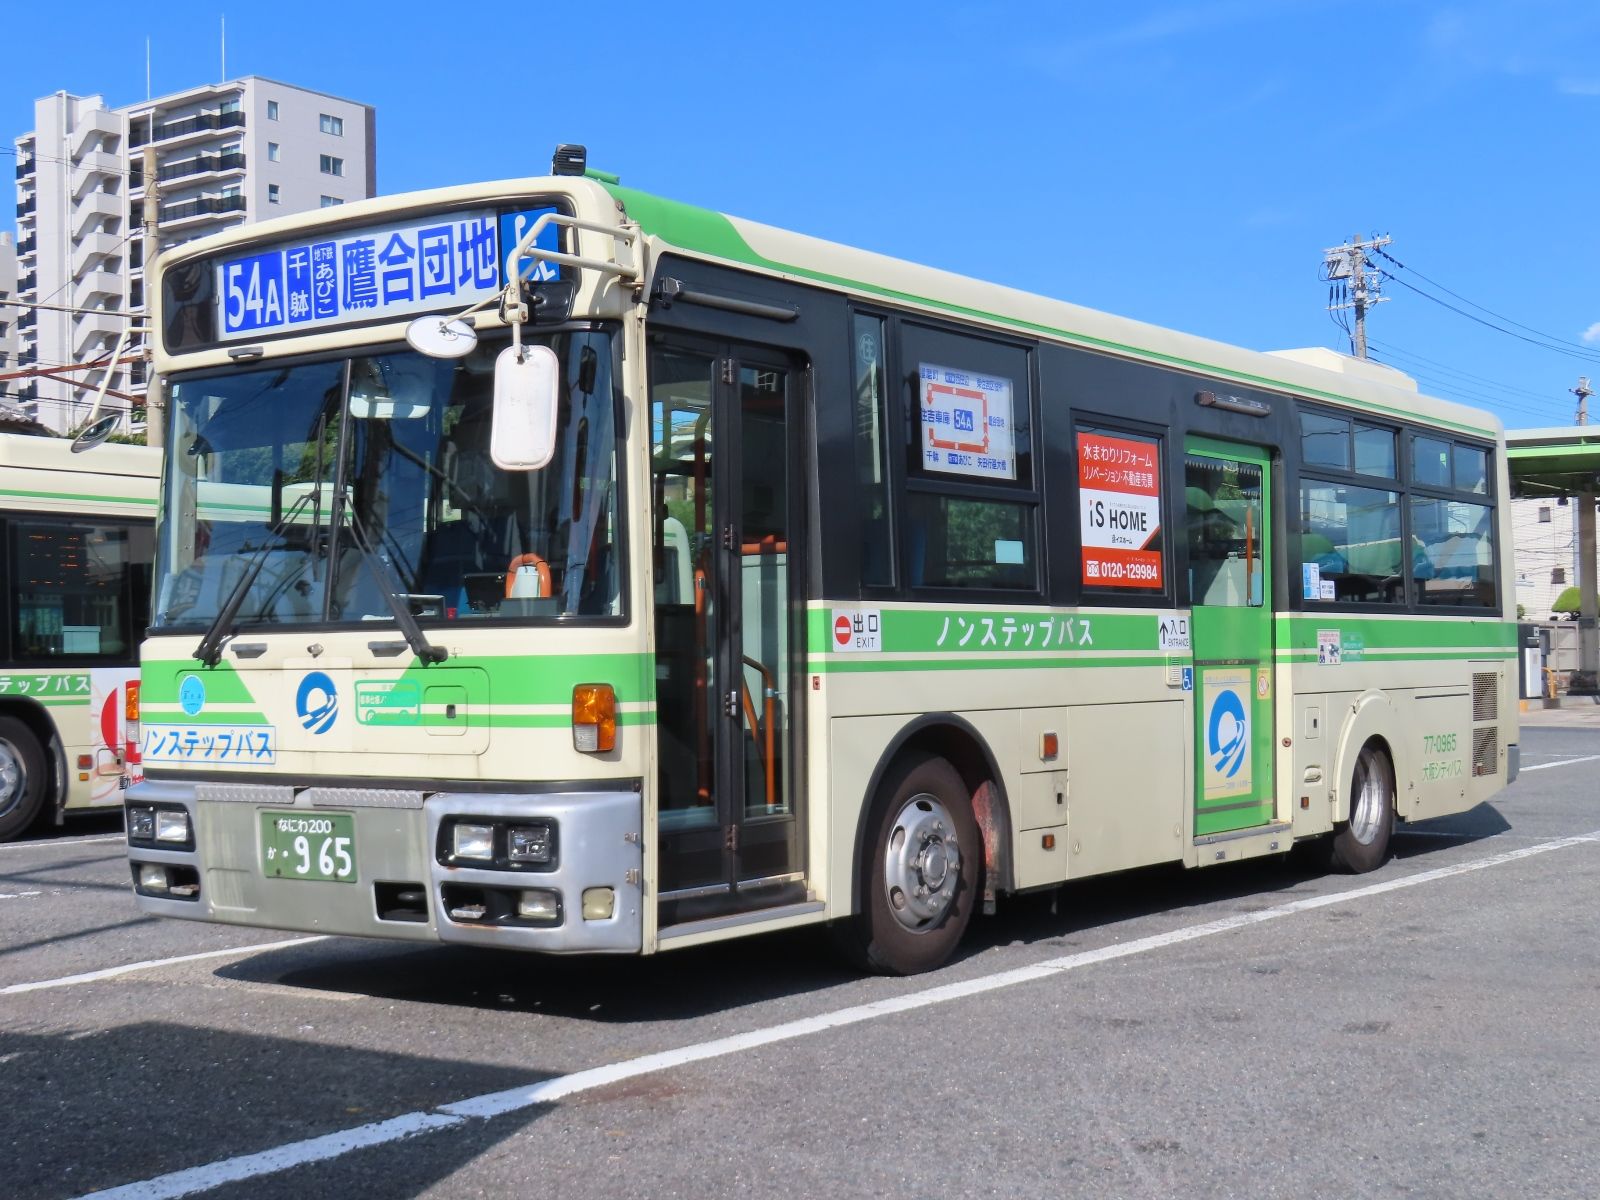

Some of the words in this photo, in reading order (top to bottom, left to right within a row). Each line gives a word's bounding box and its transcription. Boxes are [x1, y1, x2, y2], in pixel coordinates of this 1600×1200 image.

[314, 246, 334, 262] 地下鉄
[342, 216, 498, 311] 鷹合団地
[228, 260, 283, 328] 54A
[289, 252, 309, 318] 千躰
[315, 263, 335, 314] あびこ
[954, 410, 973, 431] 54A
[1083, 443, 1152, 468] 水まわりリフォーム
[1109, 508, 1147, 532] HOME
[1101, 560, 1158, 580] 0120-129984
[853, 613, 879, 634] 出口
[936, 616, 1093, 648] ノンステップバス
[1170, 619, 1186, 636] 入口
[856, 637, 876, 649] EXIT
[143, 729, 273, 759] ノンステップバス
[1423, 733, 1457, 755] 77-0965
[1422, 759, 1463, 782] 大阪シティバス
